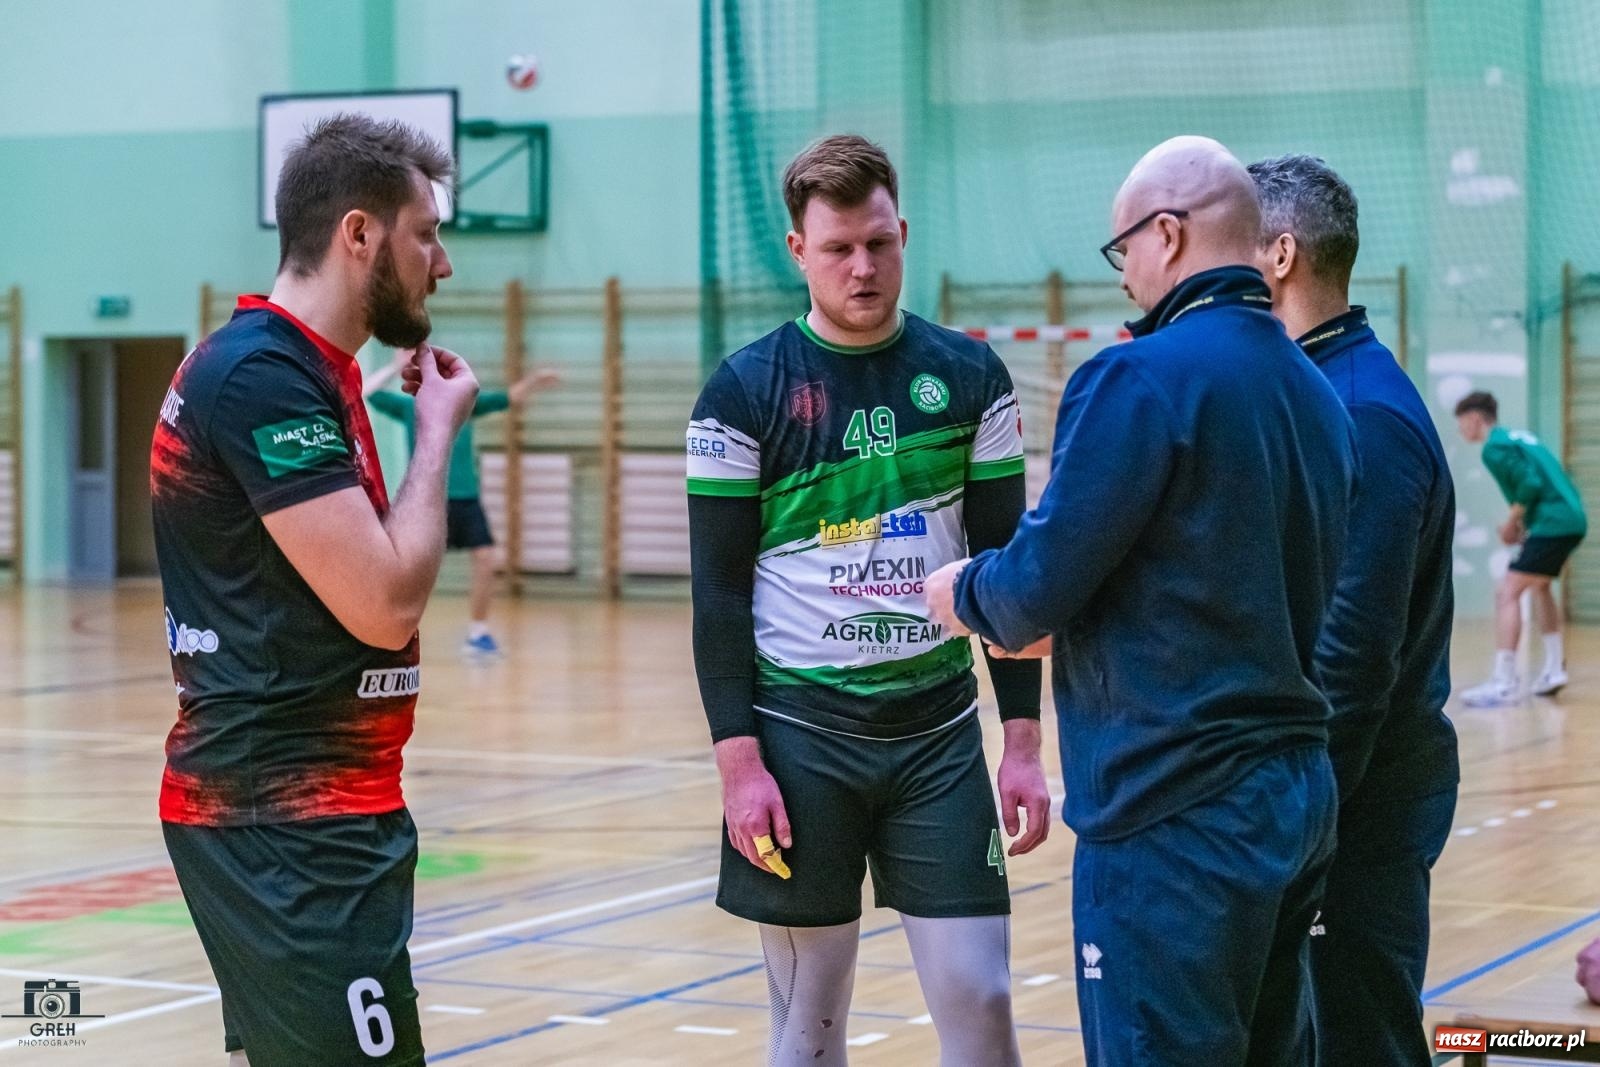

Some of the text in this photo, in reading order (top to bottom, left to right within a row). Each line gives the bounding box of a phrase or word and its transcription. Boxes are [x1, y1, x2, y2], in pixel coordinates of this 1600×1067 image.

[842, 405, 897, 459] 49
[829, 556, 927, 584] PIVEXIN
[829, 581, 926, 598] TECHNOLOG
[858, 644, 901, 655] KIETRZ
[986, 828, 1005, 876] 4
[347, 976, 396, 1058] 6
